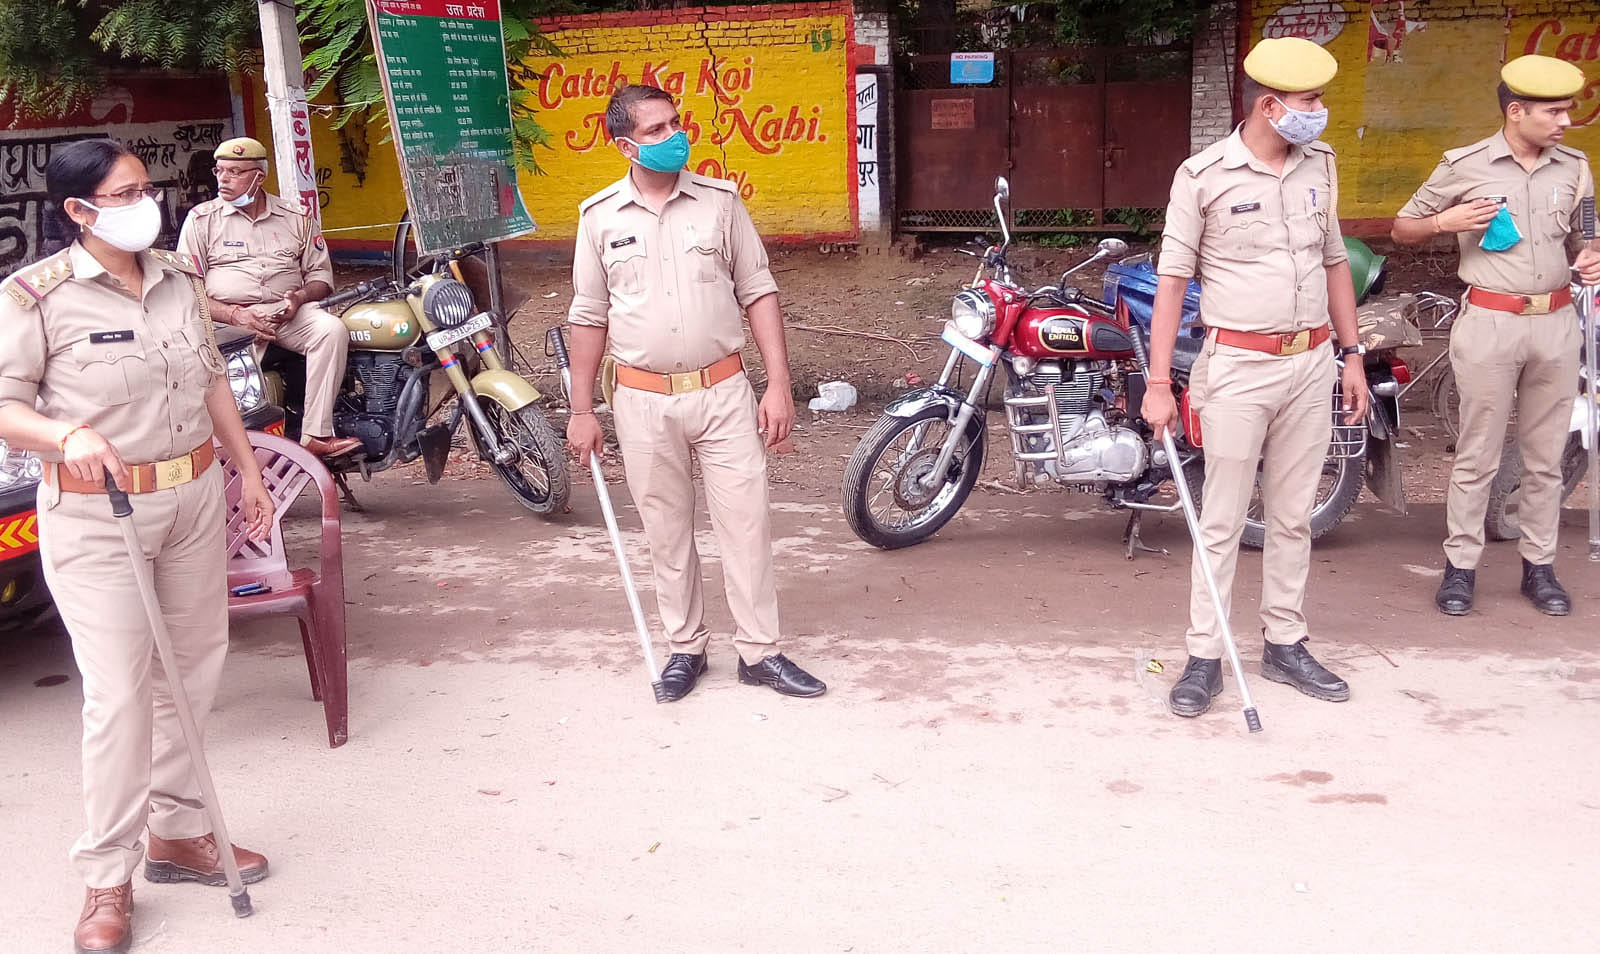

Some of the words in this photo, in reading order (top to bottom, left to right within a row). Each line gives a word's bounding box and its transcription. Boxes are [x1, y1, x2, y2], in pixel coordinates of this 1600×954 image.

[445, 4, 464, 16] उत्तर
[466, 2, 485, 18] प्रदेश
[538, 61, 628, 109] Catch
[640, 60, 685, 97] Ka
[695, 56, 753, 105] Koi
[711, 105, 827, 154] Nahi.
[392, 322, 409, 334] 49
[1048, 333, 1079, 342] ENFIELD
